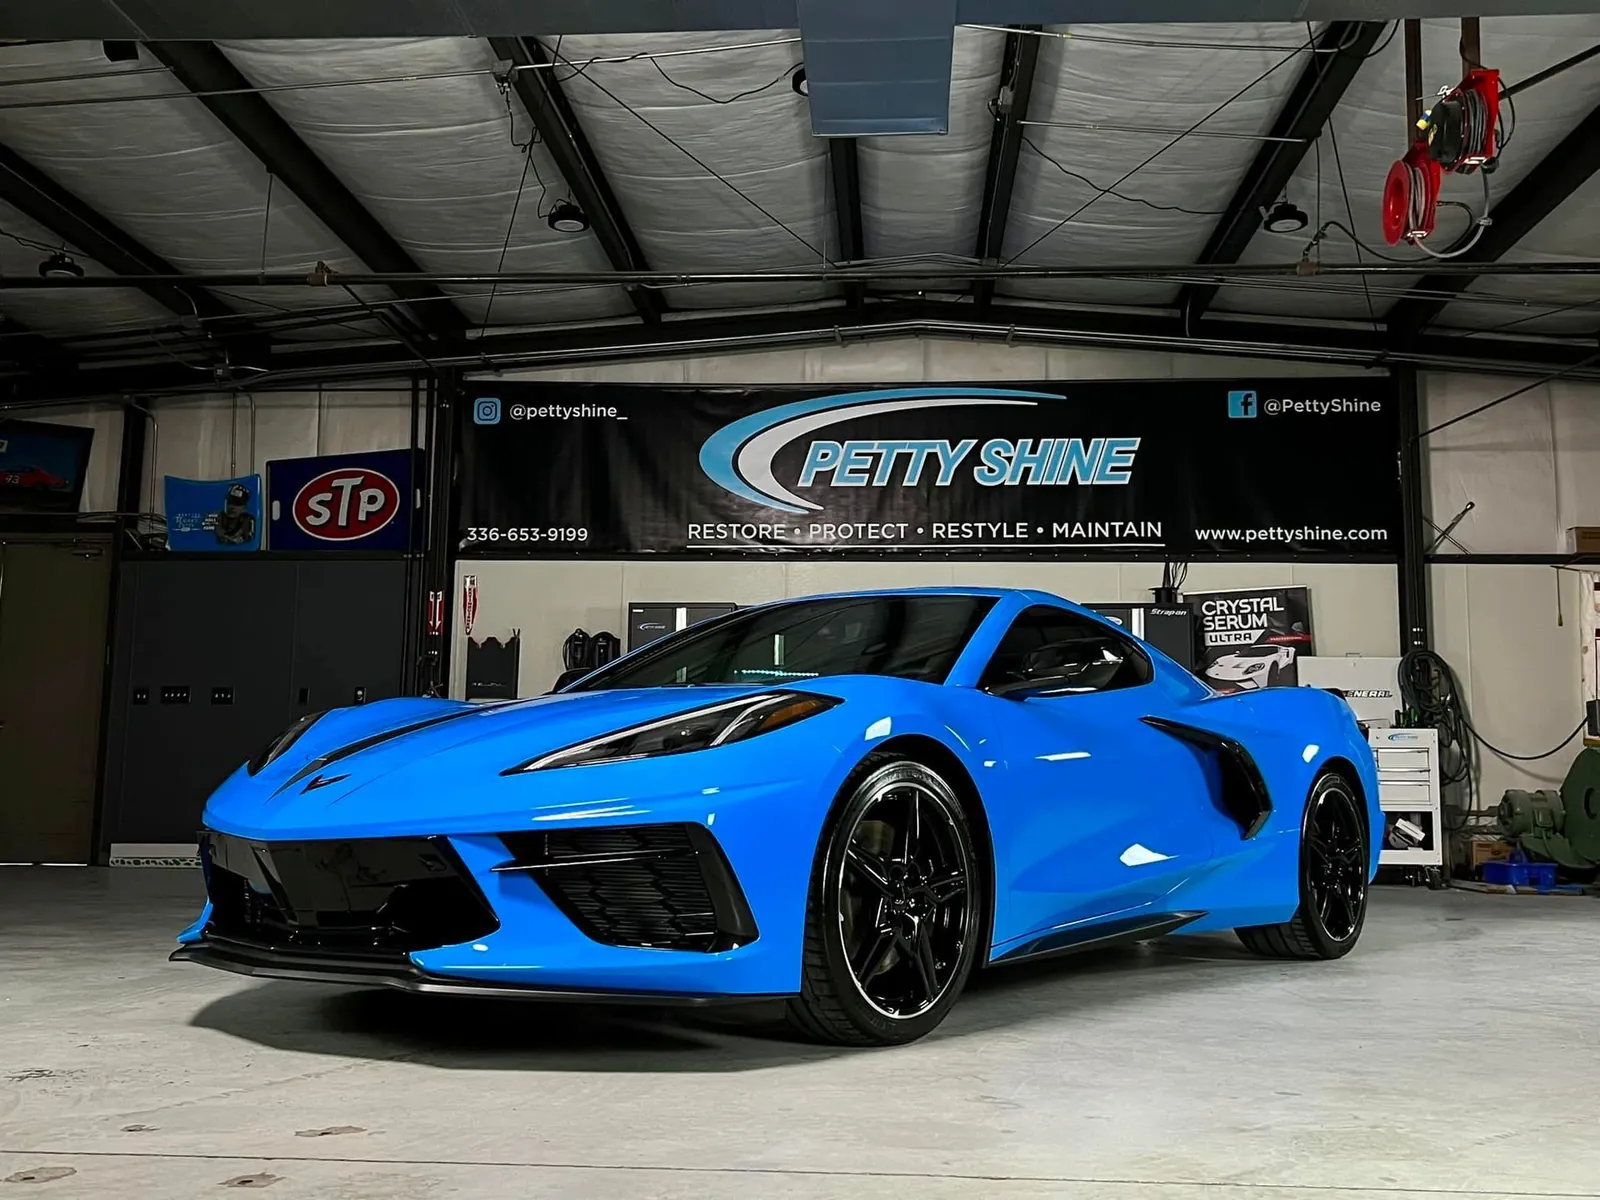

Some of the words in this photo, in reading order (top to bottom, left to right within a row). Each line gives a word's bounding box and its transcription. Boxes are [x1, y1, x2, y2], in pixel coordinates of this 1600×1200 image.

[510, 404, 628, 420] @pettyshine_
[1264, 398, 1381, 415] @PettyShine
[797, 439, 978, 487] PETTY
[973, 437, 1141, 486] SHINE
[306, 476, 385, 526] STP
[466, 527, 588, 541] 336-653-9199
[688, 523, 785, 540] RESTORE
[808, 523, 908, 539] PROTECT
[933, 523, 1029, 539] RESTYLE
[1053, 522, 1162, 539] MAINTAIN
[1195, 526, 1388, 542] www.pettyshine.com
[1202, 597, 1285, 616] CRYSTAL
[1203, 613, 1268, 632] SERUM
[1209, 632, 1251, 643] ULTRA
